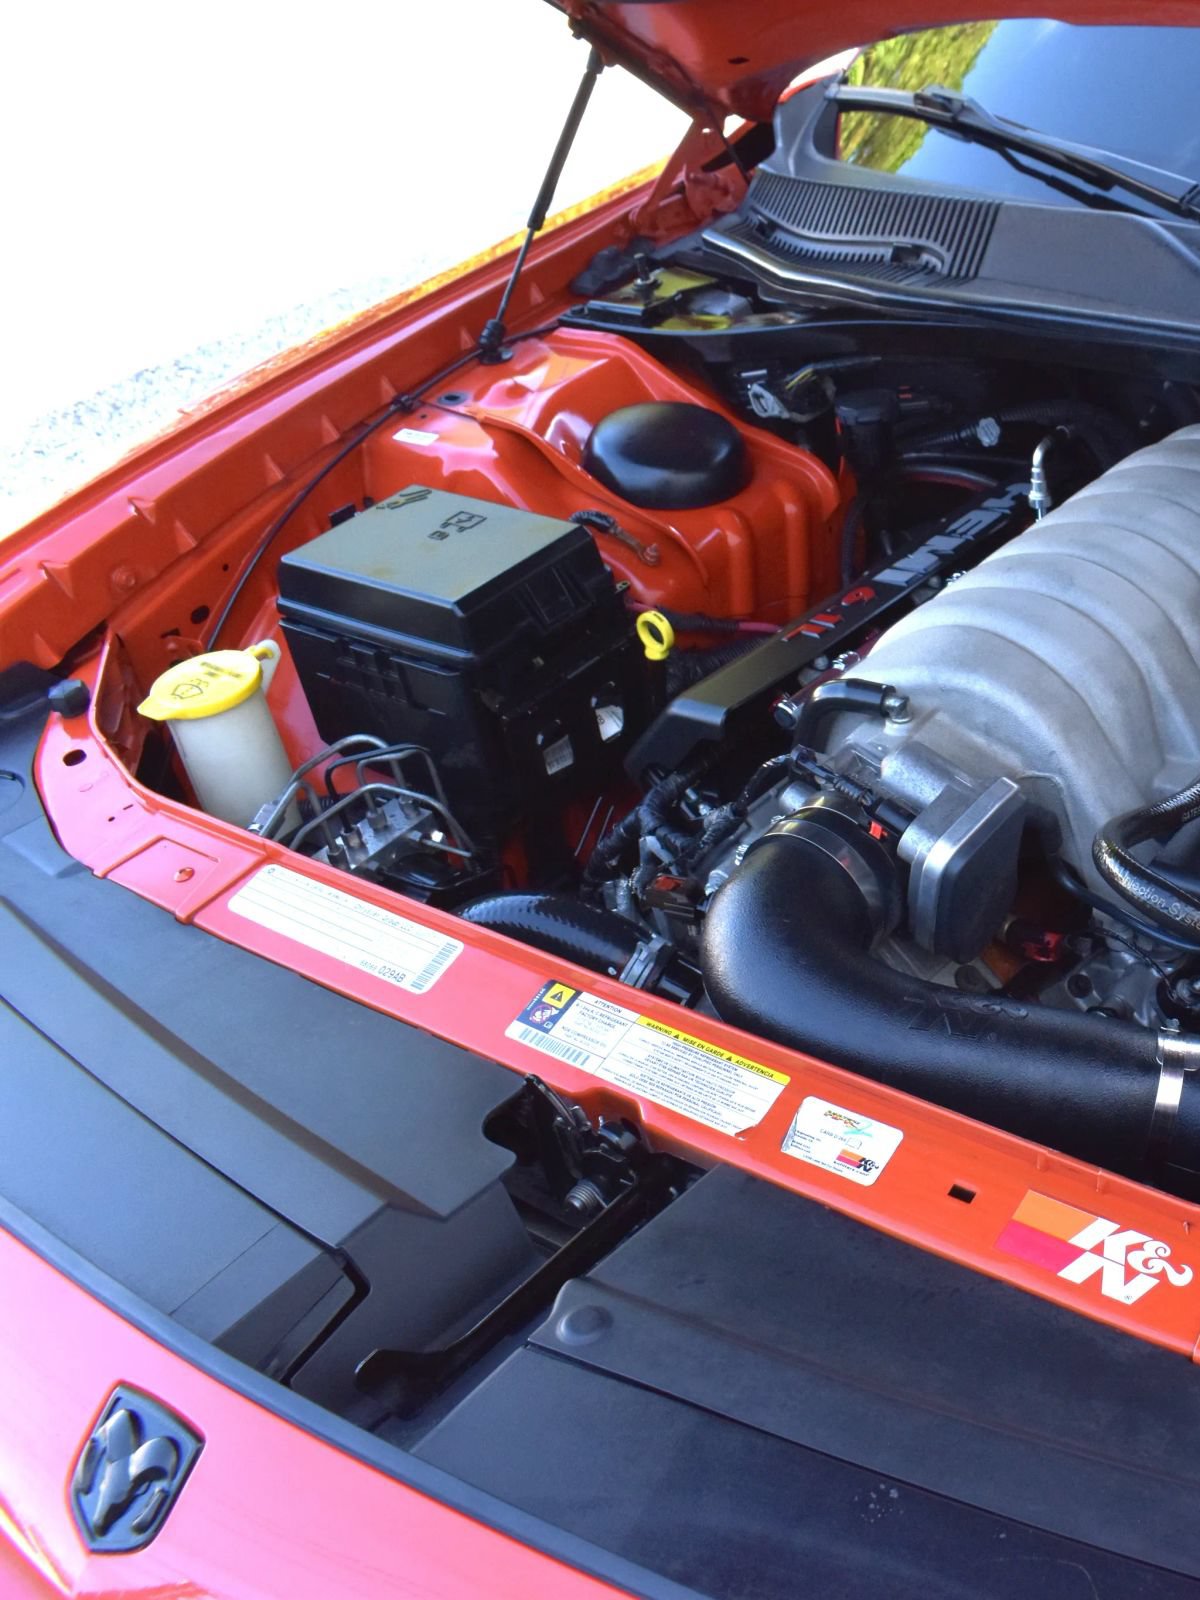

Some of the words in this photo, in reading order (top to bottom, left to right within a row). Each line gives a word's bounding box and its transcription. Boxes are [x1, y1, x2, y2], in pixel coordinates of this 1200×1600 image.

[1121, 869, 1166, 909] Injection
[593, 999, 622, 1013] ATTENTION
[645, 1022, 672, 1035] WARNING
[681, 1037, 697, 1046] MISE
[704, 1046, 724, 1057] GARDE
[734, 1059, 774, 1078] ADVERTENCIA
[1056, 1216, 1194, 1306] K&N
